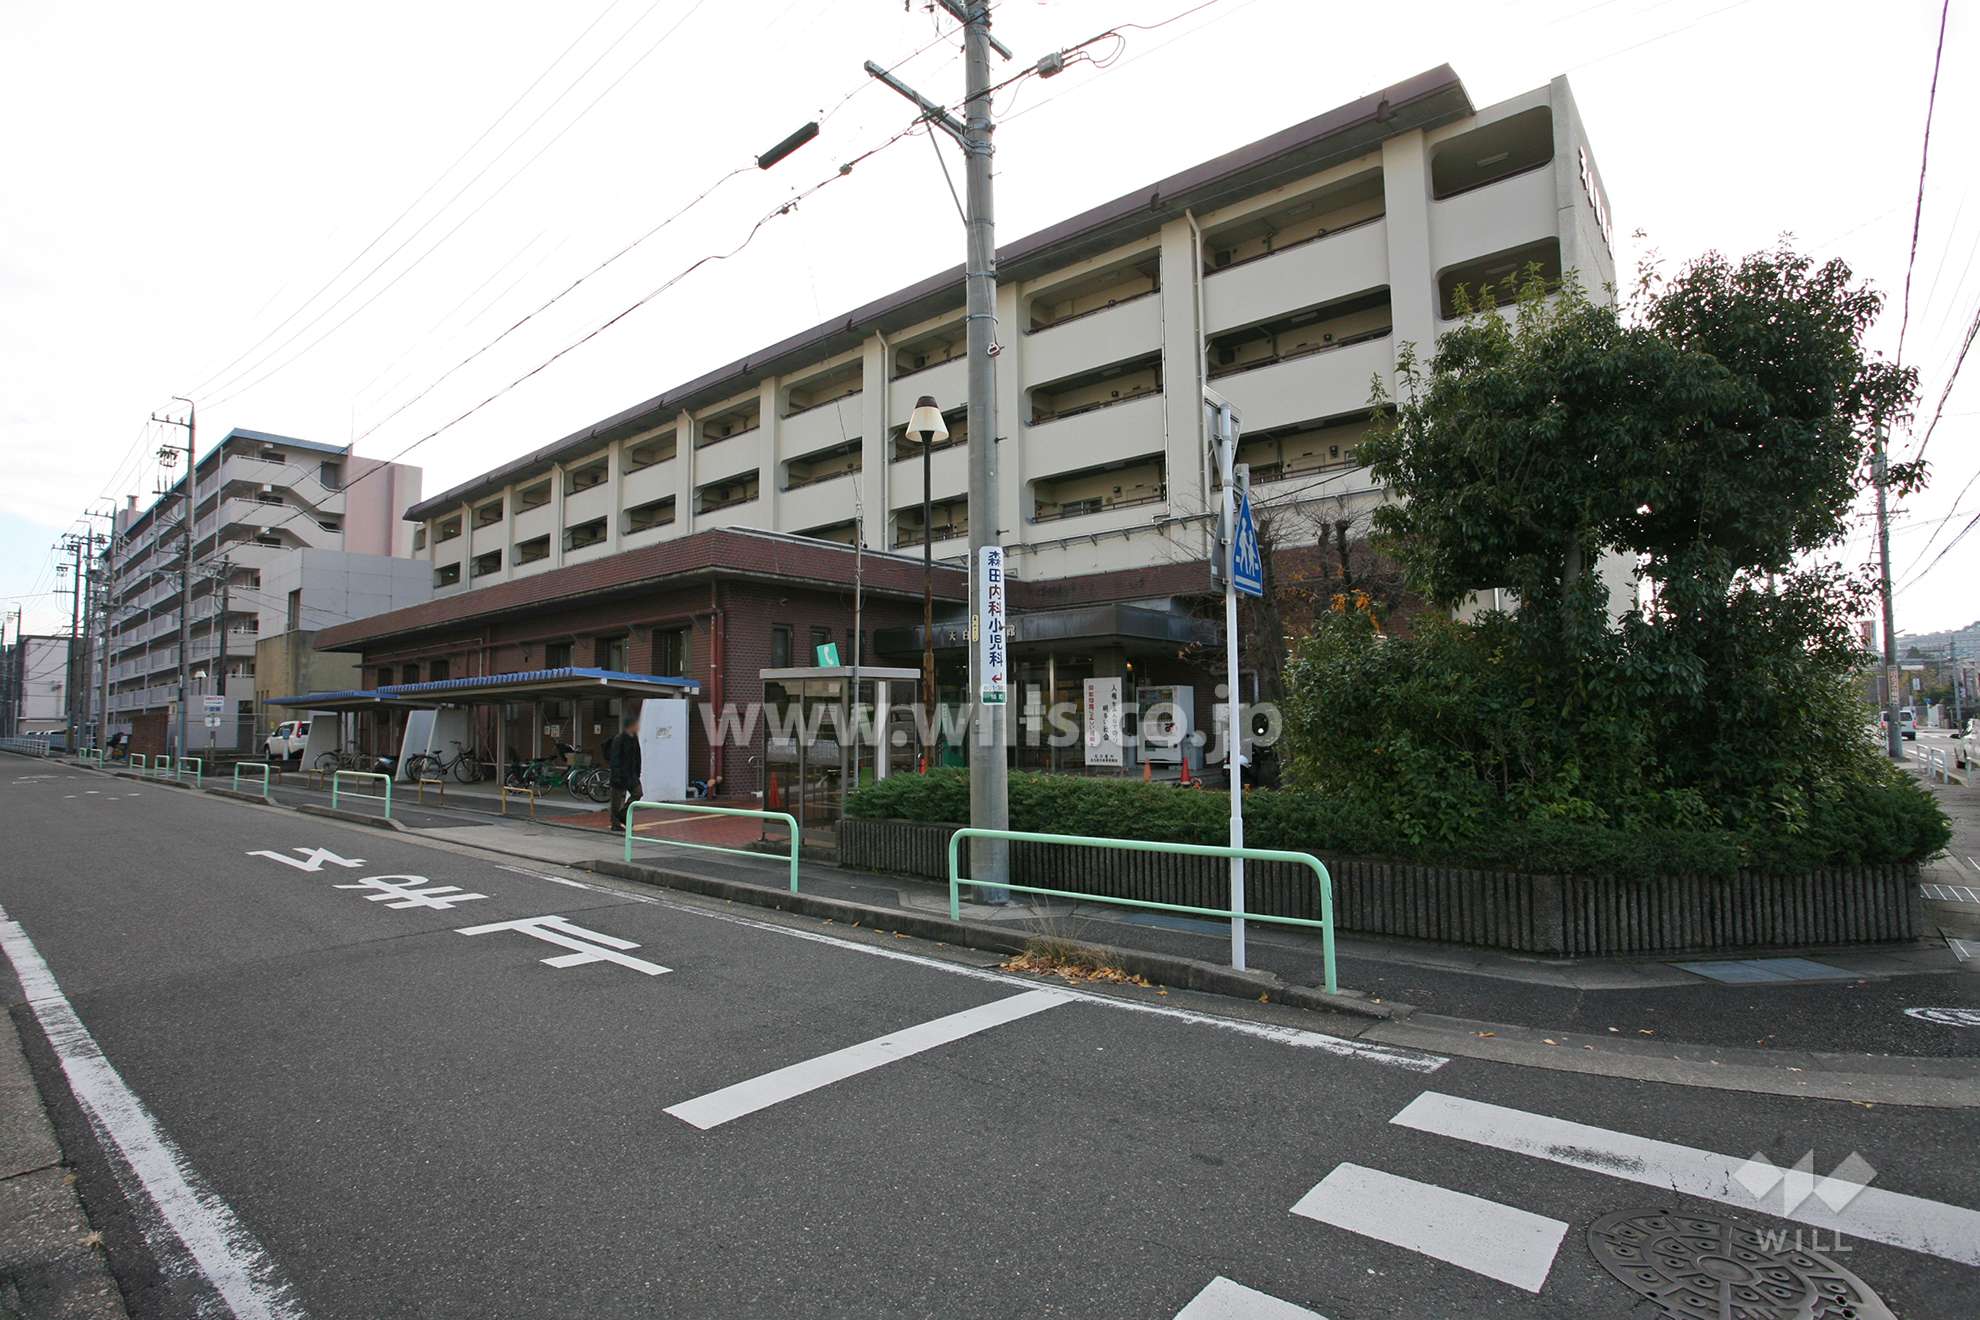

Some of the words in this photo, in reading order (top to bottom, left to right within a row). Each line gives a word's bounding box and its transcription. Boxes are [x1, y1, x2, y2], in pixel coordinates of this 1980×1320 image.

[987, 551, 1003, 668] 森田内科小児科
[245, 847, 674, 976] 止まれ
